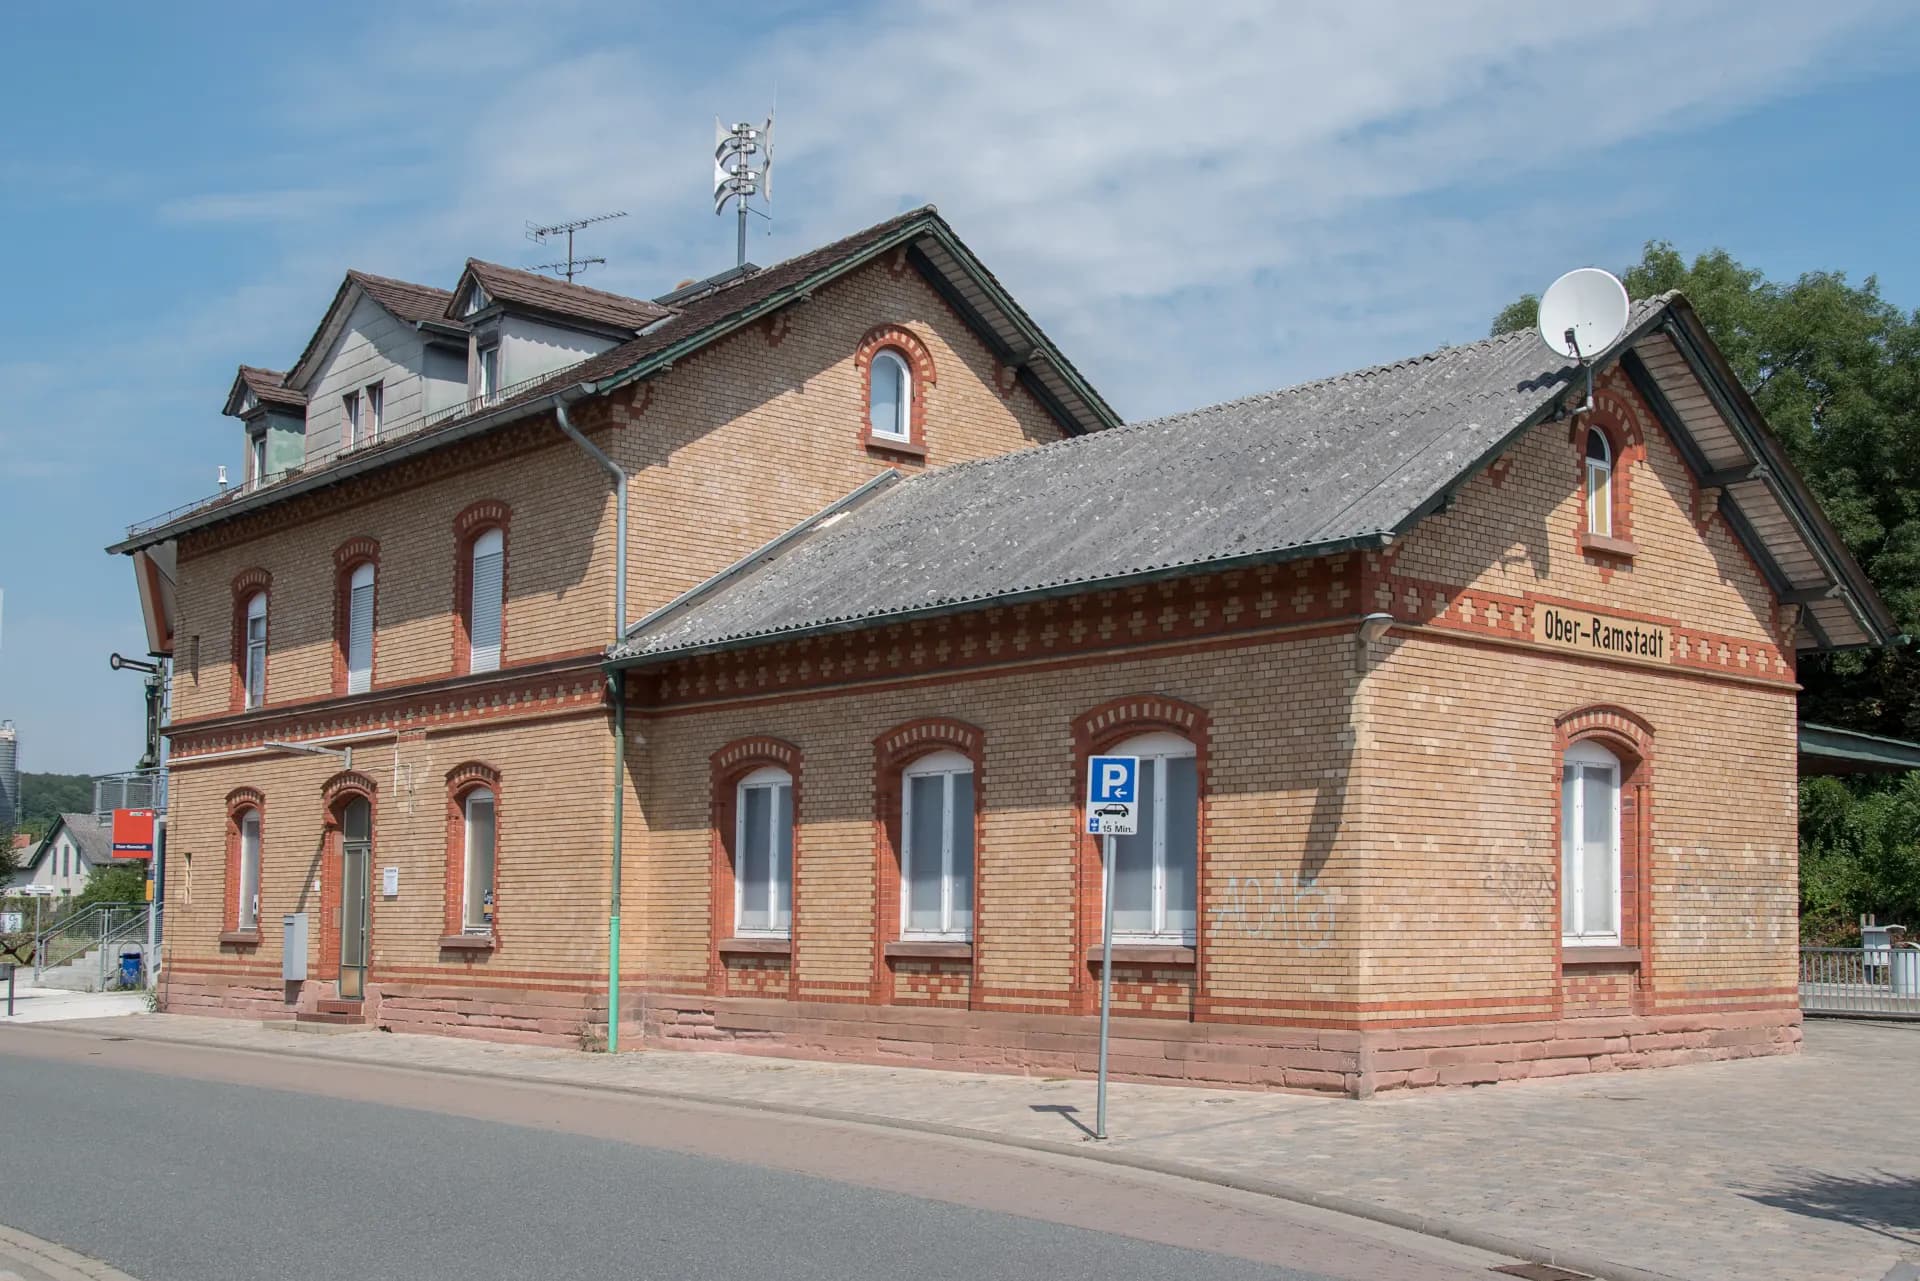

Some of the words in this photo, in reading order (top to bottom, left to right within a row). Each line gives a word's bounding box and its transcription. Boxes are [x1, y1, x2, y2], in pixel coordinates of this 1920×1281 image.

[1544, 609, 1664, 659] Ober-Ramstadt
[1101, 763, 1128, 798] P
[1103, 825, 1112, 833] 15
[1115, 825, 1133, 833] Min.
